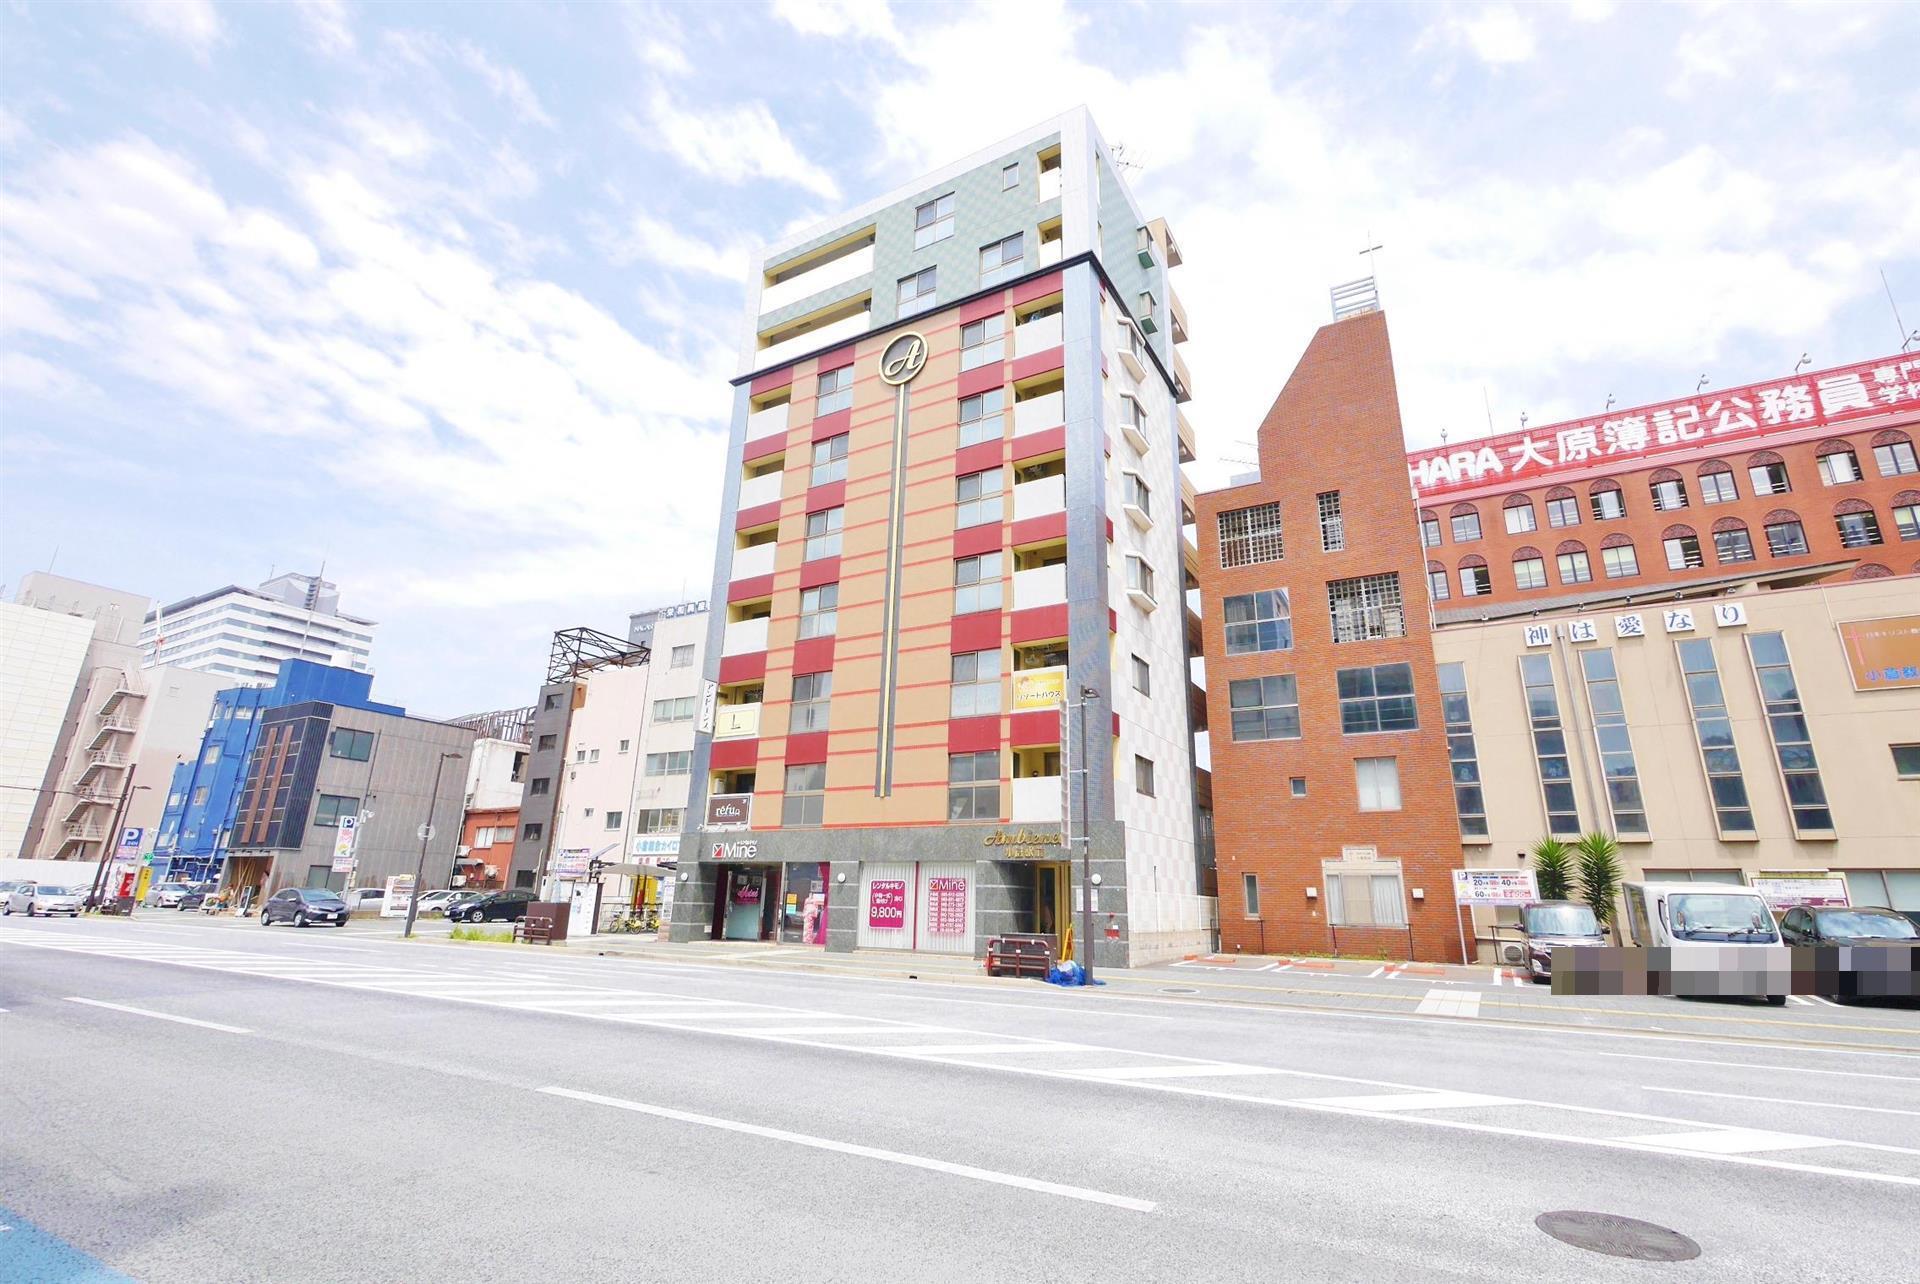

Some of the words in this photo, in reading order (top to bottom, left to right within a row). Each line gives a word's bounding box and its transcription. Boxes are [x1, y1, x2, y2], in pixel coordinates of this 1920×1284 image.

[1508, 373, 1874, 473] 大原簿記公務員
[1527, 606, 1739, 644] 神は愛なり
[723, 842, 758, 858] Mine
[939, 879, 966, 891] Mine
[871, 906, 903, 919] 9,800円
